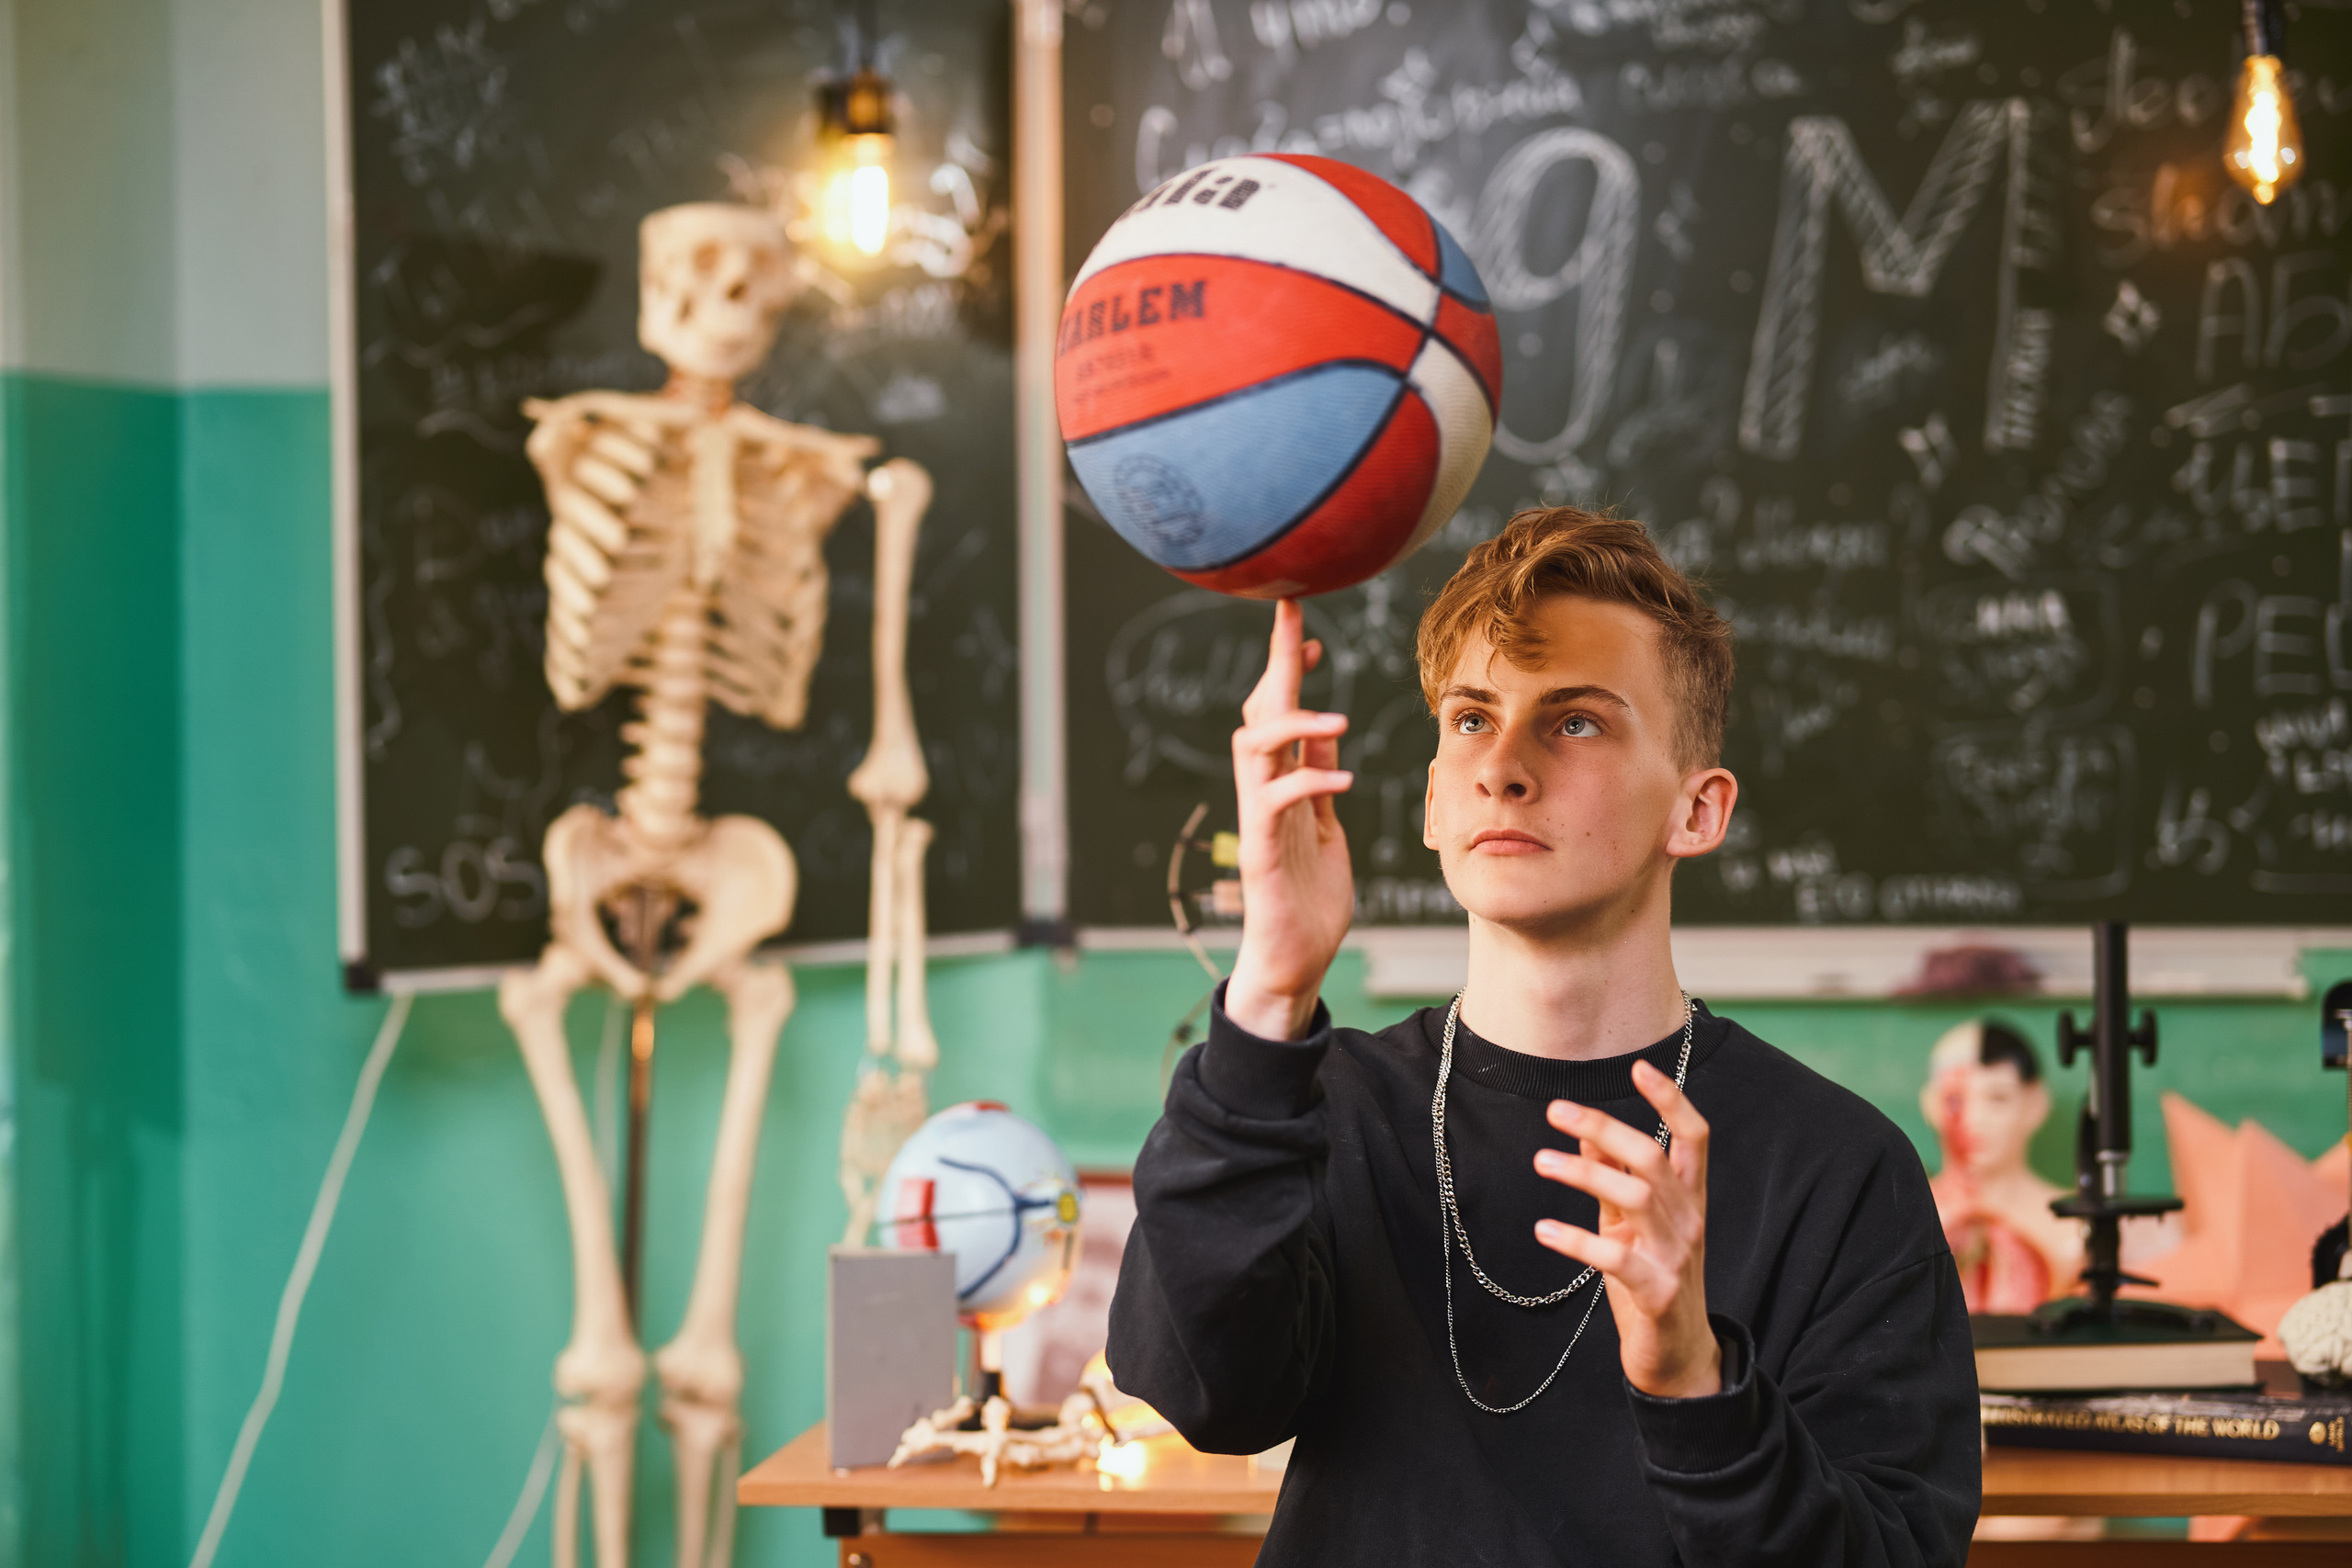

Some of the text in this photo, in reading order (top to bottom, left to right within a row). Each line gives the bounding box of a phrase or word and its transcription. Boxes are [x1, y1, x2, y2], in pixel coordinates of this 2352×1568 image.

[2144, 1413, 2170, 1436] OF
[2174, 1415, 2211, 1438] THE
[2211, 1417, 2280, 1440] WORLD
